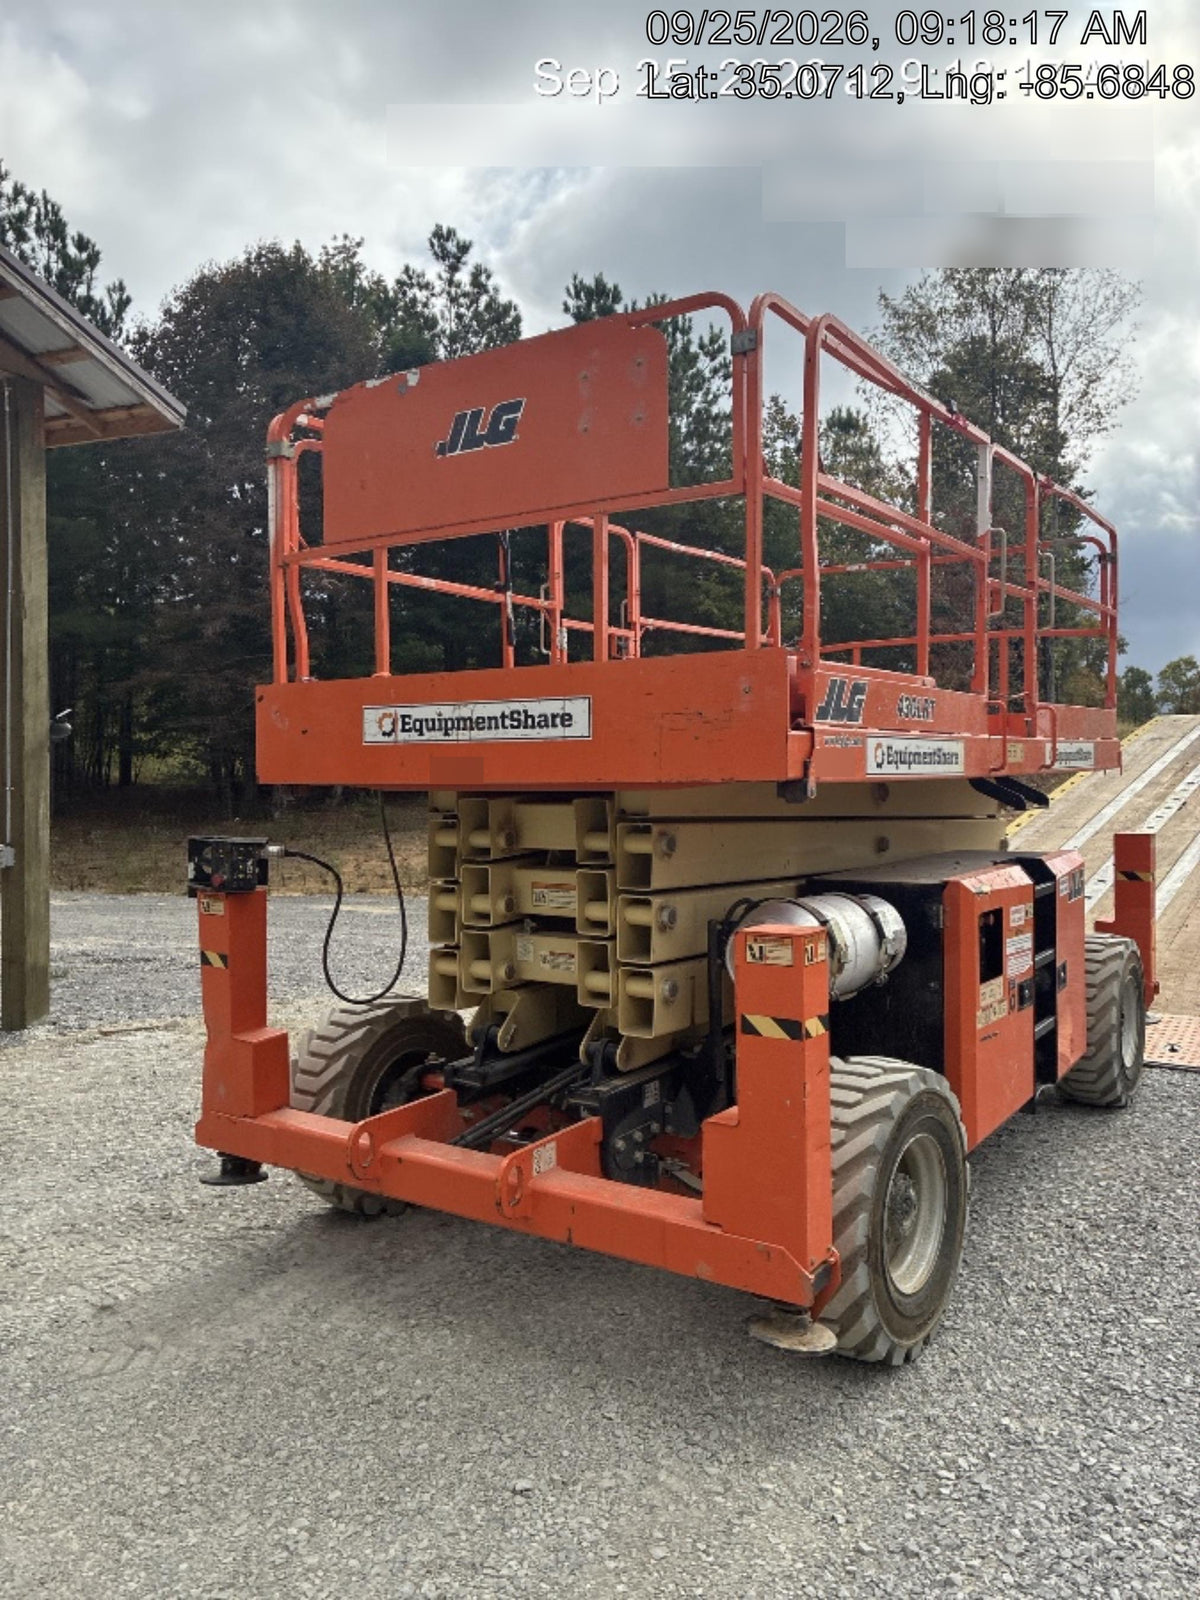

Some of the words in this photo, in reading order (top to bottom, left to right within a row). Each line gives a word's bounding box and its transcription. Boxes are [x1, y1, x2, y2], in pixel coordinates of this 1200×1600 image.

[435, 398, 527, 459] JLG
[815, 677, 868, 724] JLG
[400, 709, 573, 737] EquipmentShare
[886, 745, 959, 770] EquipmentShare
